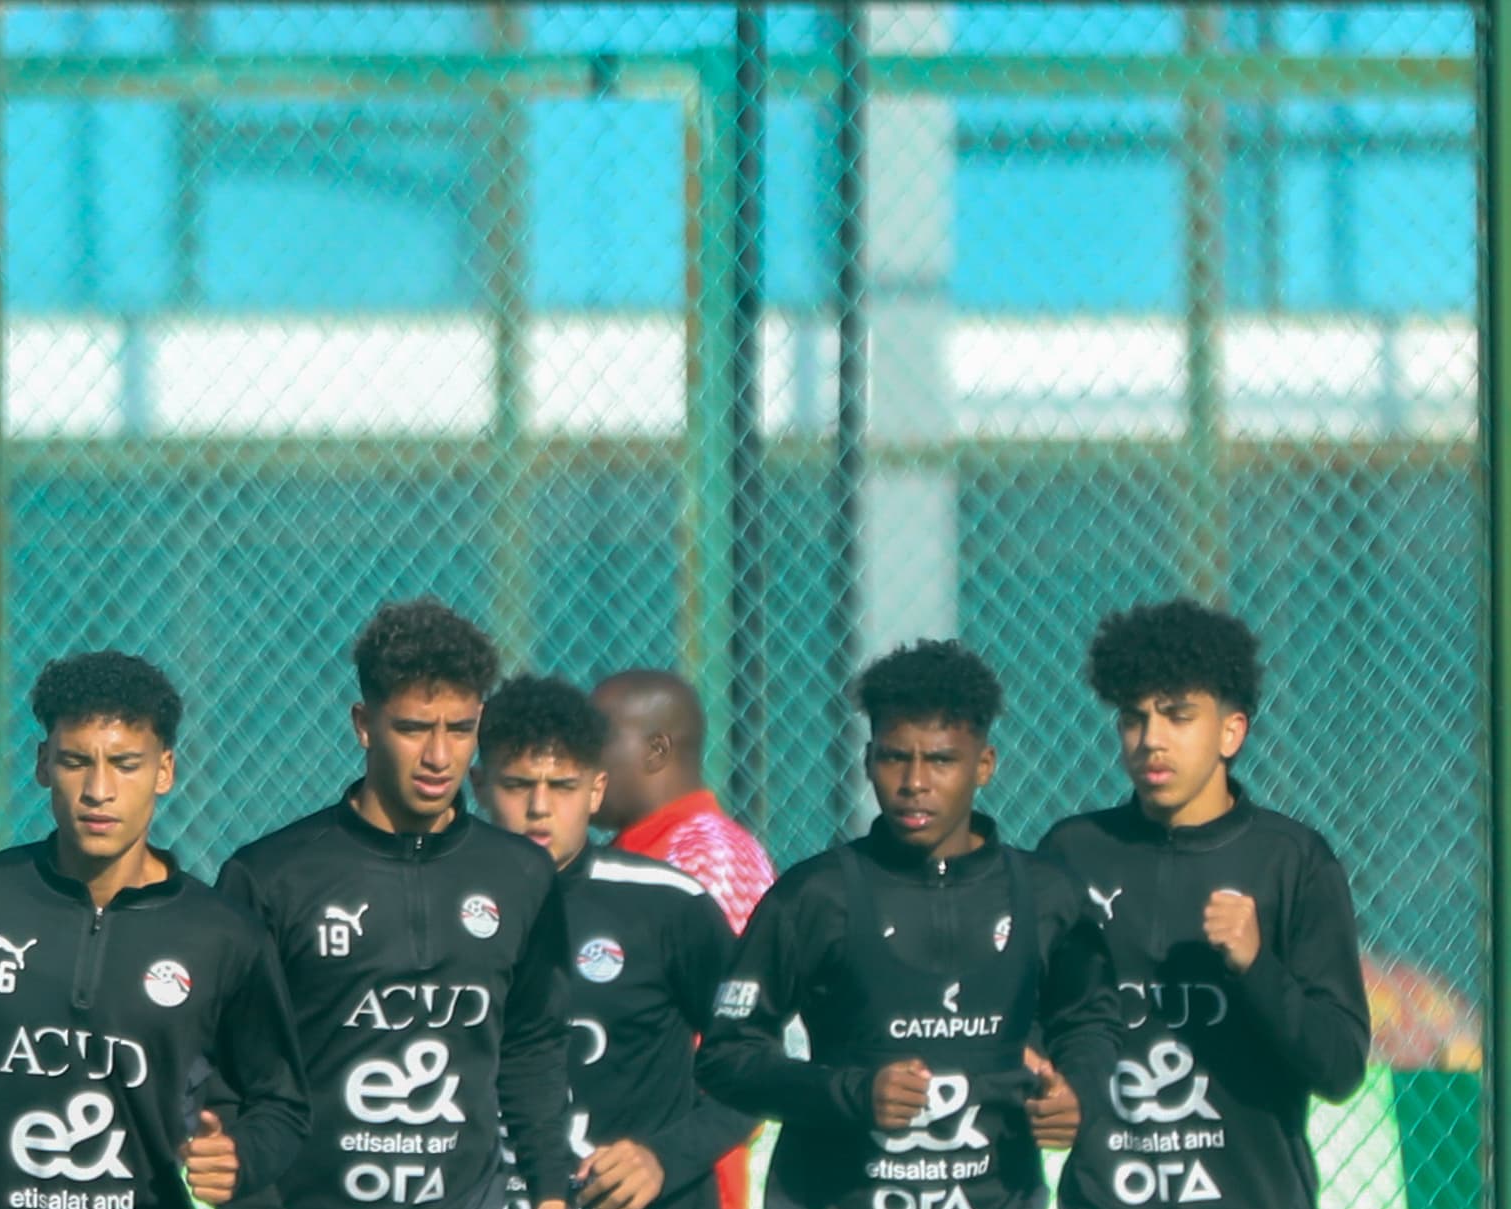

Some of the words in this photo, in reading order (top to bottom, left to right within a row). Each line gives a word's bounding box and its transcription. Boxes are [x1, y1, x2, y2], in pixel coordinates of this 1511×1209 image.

[318, 924, 350, 957] 19
[343, 984, 490, 1031] ACUD
[1118, 981, 1228, 1029] CUD
[890, 1015, 1003, 1040] CATAPULT
[340, 1131, 423, 1154] etisalat
[1184, 1129, 1225, 1150] and
[865, 1157, 949, 1181] etisalat
[952, 1154, 990, 1180] and
